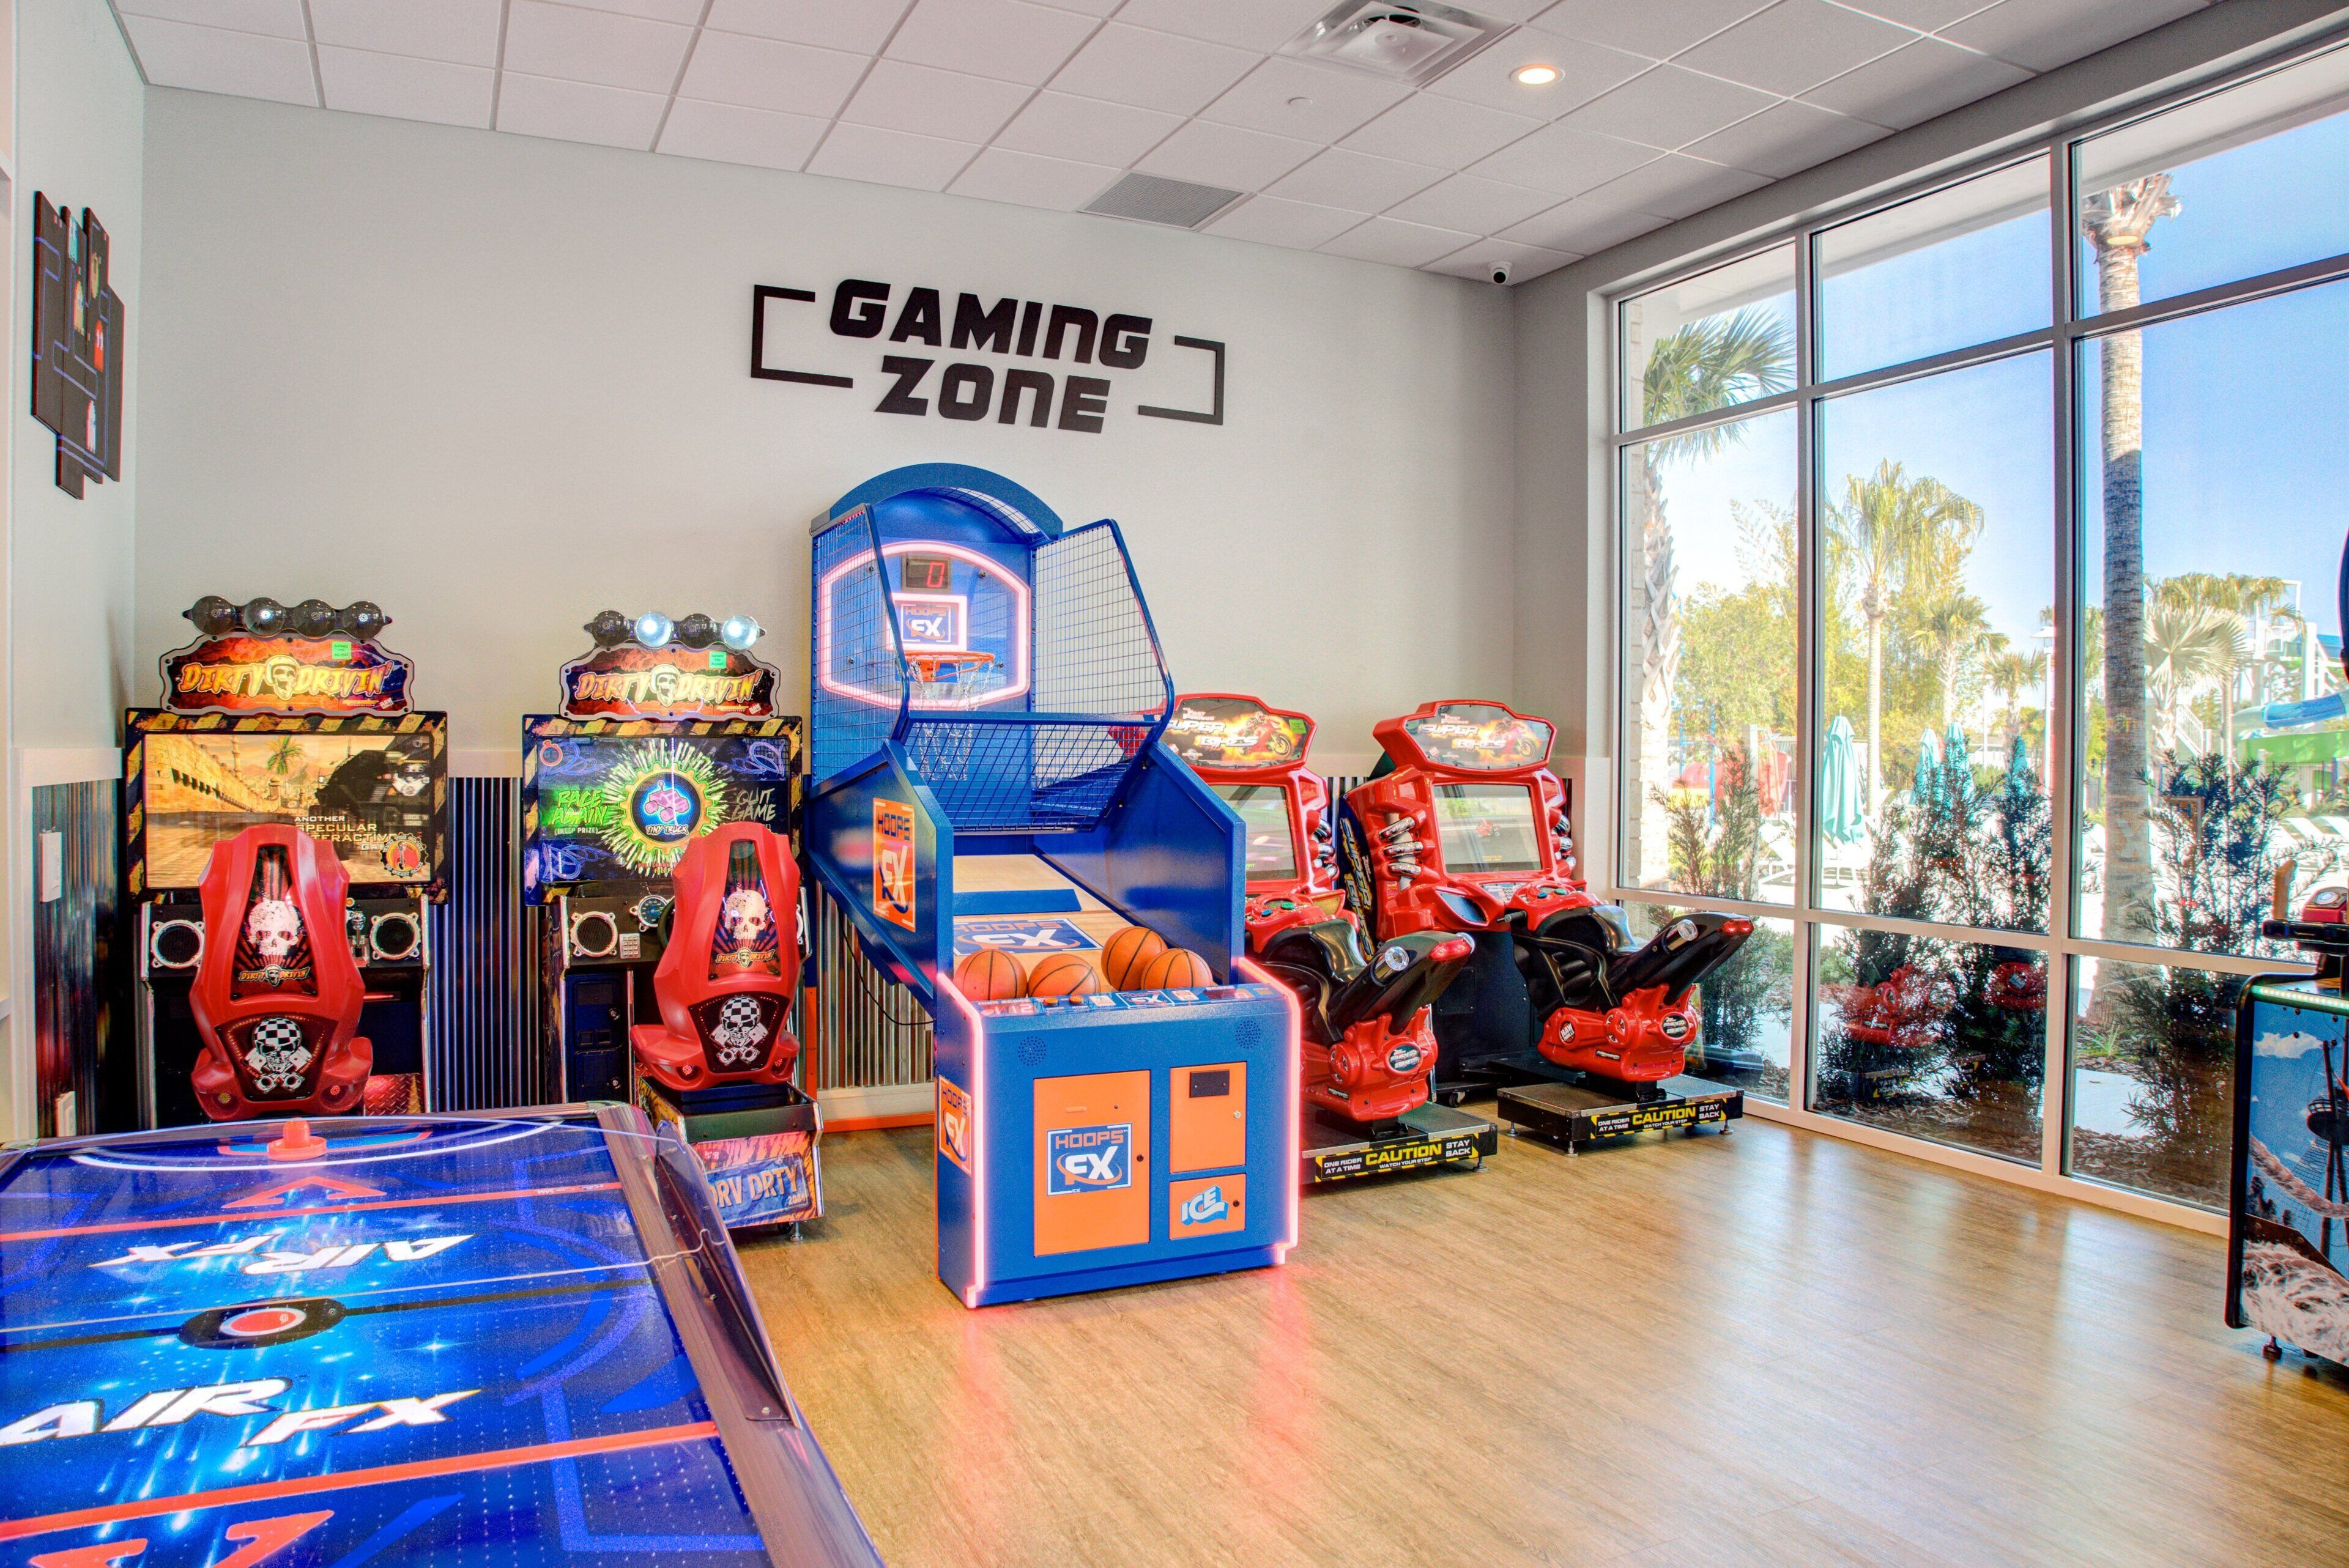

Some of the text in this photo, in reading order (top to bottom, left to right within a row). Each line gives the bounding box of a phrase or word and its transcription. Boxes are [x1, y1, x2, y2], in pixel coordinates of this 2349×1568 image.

[829, 279, 1153, 370] GAMING
[874, 355, 1111, 434] ZONE
[927, 562, 946, 588] 0
[179, 662, 265, 697] DIRTY
[575, 672, 651, 703] DIRTY
[558, 790, 602, 807] RACE
[737, 787, 776, 805] QUIT
[730, 804, 777, 822] GAME
[878, 810, 910, 841] HOOPS
[646, 825, 689, 835] TINY TRUCK
[882, 845, 908, 908] FX
[1340, 818, 1371, 909] SUPER
[972, 929, 1068, 949] FX
[943, 1085, 968, 1117] HOOPS
[1632, 1107, 1696, 1125] CAUTION
[1699, 1103, 1720, 1112] STAY
[1699, 1111, 1720, 1120] BACK
[945, 1112, 967, 1157] FX
[1055, 1130, 1124, 1149] HOOPS
[1446, 1140, 1469, 1148] STAY
[1064, 1145, 1119, 1185] FX
[1365, 1144, 1442, 1166] CAUTION
[1446, 1148, 1471, 1157] BACK
[748, 1164, 798, 1202] DRTY
[1181, 1185, 1229, 1226] ICE
[87, 1228, 286, 1268] FX
[242, 1233, 481, 1275] AIR
[0, 1377, 292, 1446] AIR
[239, 1388, 489, 1448] FX
